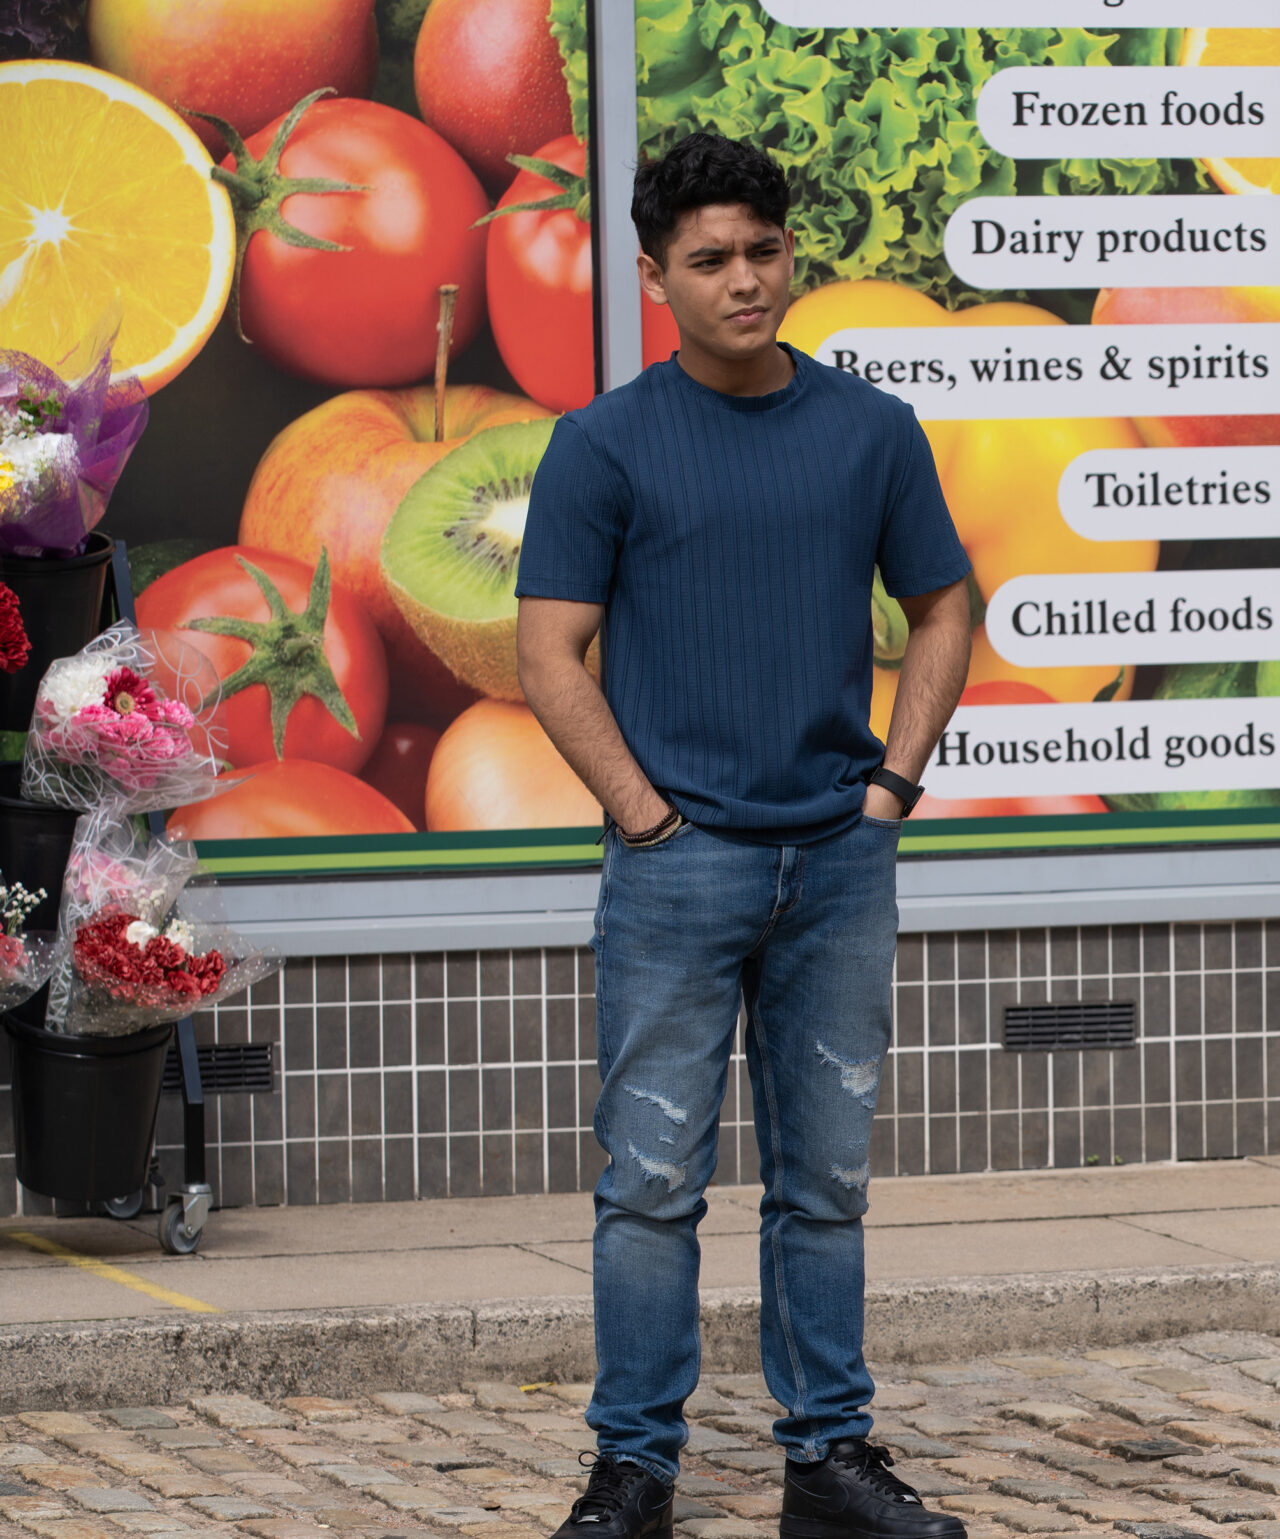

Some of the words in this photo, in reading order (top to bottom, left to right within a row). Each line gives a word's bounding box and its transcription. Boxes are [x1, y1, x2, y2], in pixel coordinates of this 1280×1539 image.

[1013, 92, 1148, 126] Frozen
[1162, 91, 1265, 125] foods
[972, 220, 1084, 262] Dairy
[1097, 218, 1267, 262] products
[970, 348, 1083, 382] wines
[1100, 346, 1132, 380] &
[1149, 345, 1269, 387] spirits
[1085, 471, 1271, 507] Toiletries
[1012, 599, 1156, 636] Chilled
[1171, 597, 1273, 632] foods
[936, 726, 1150, 766] Household
[1165, 723, 1276, 767] goods
